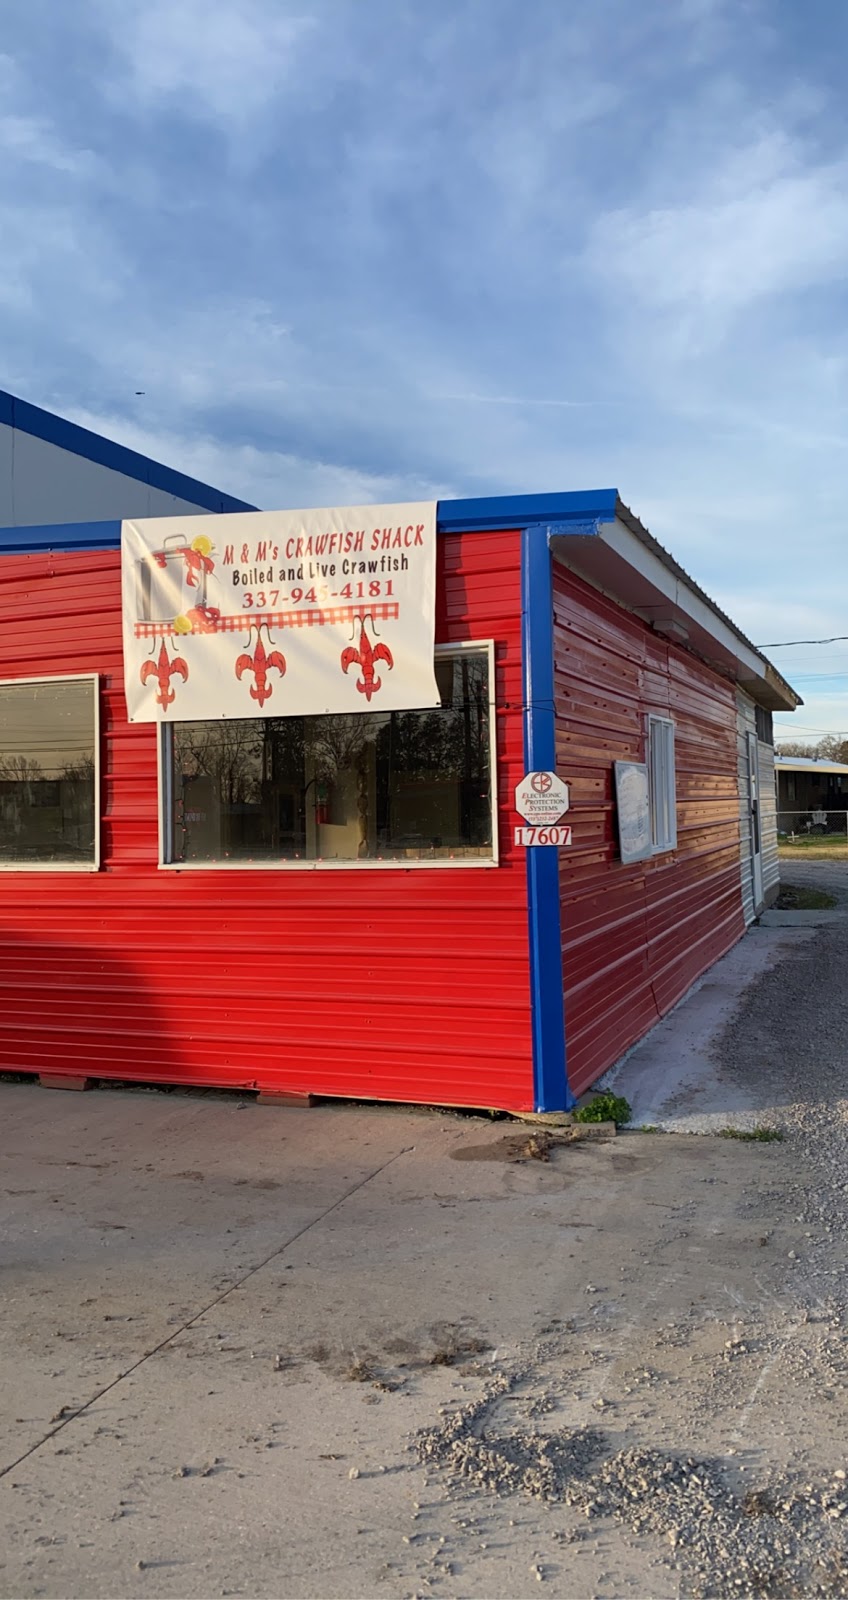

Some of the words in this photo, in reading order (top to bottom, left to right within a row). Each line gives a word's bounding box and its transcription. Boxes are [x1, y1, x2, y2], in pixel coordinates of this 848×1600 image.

[222, 544, 234, 566] M
[240, 542, 249, 564] &
[255, 540, 279, 562] M's
[285, 530, 365, 559] CRAWFISH
[370, 524, 425, 551] SHACK
[232, 565, 273, 586] Boiled
[279, 562, 304, 581] and
[309, 561, 336, 579] Live
[342, 552, 409, 575] Crawfish
[242, 579, 394, 609] 337-945-4181
[516, 827, 570, 845] 17607
